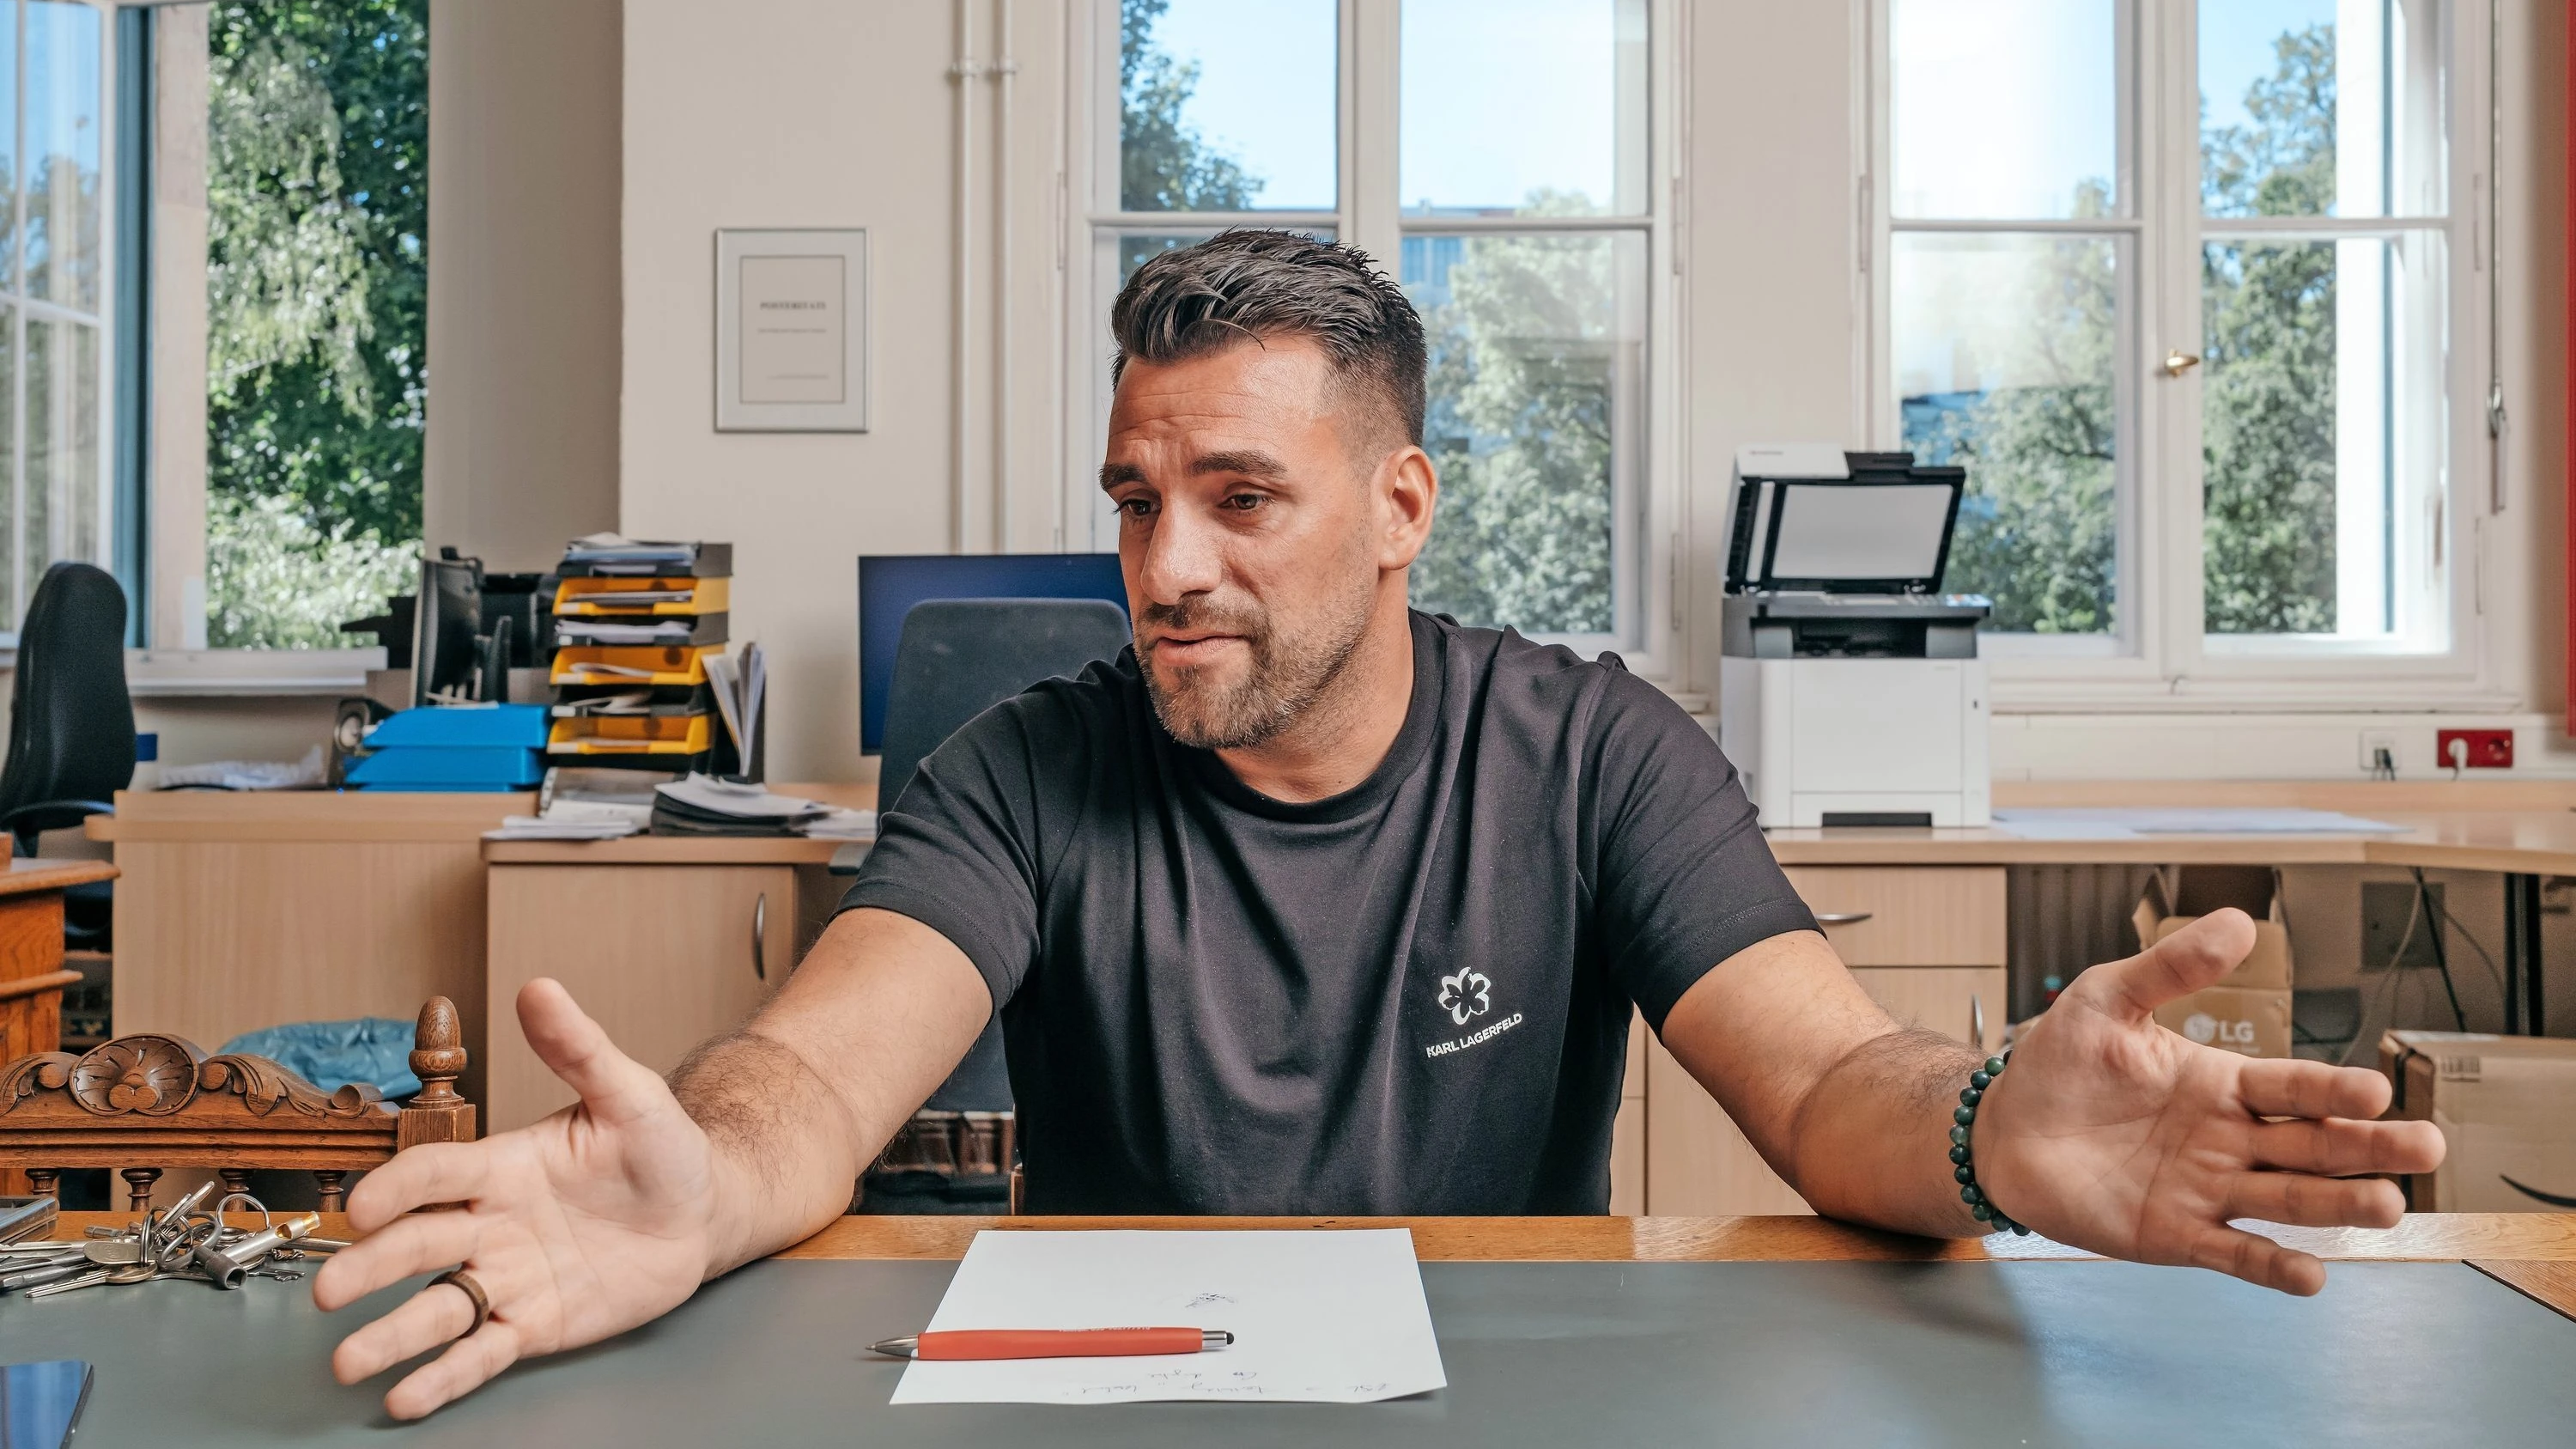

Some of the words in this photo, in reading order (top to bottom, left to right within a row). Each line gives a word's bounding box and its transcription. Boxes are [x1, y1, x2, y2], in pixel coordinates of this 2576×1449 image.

[1426, 1041, 1460, 1058] KARL
[1460, 1013, 1522, 1049] LAGERFELD
[2219, 1020, 2255, 1043] LG
